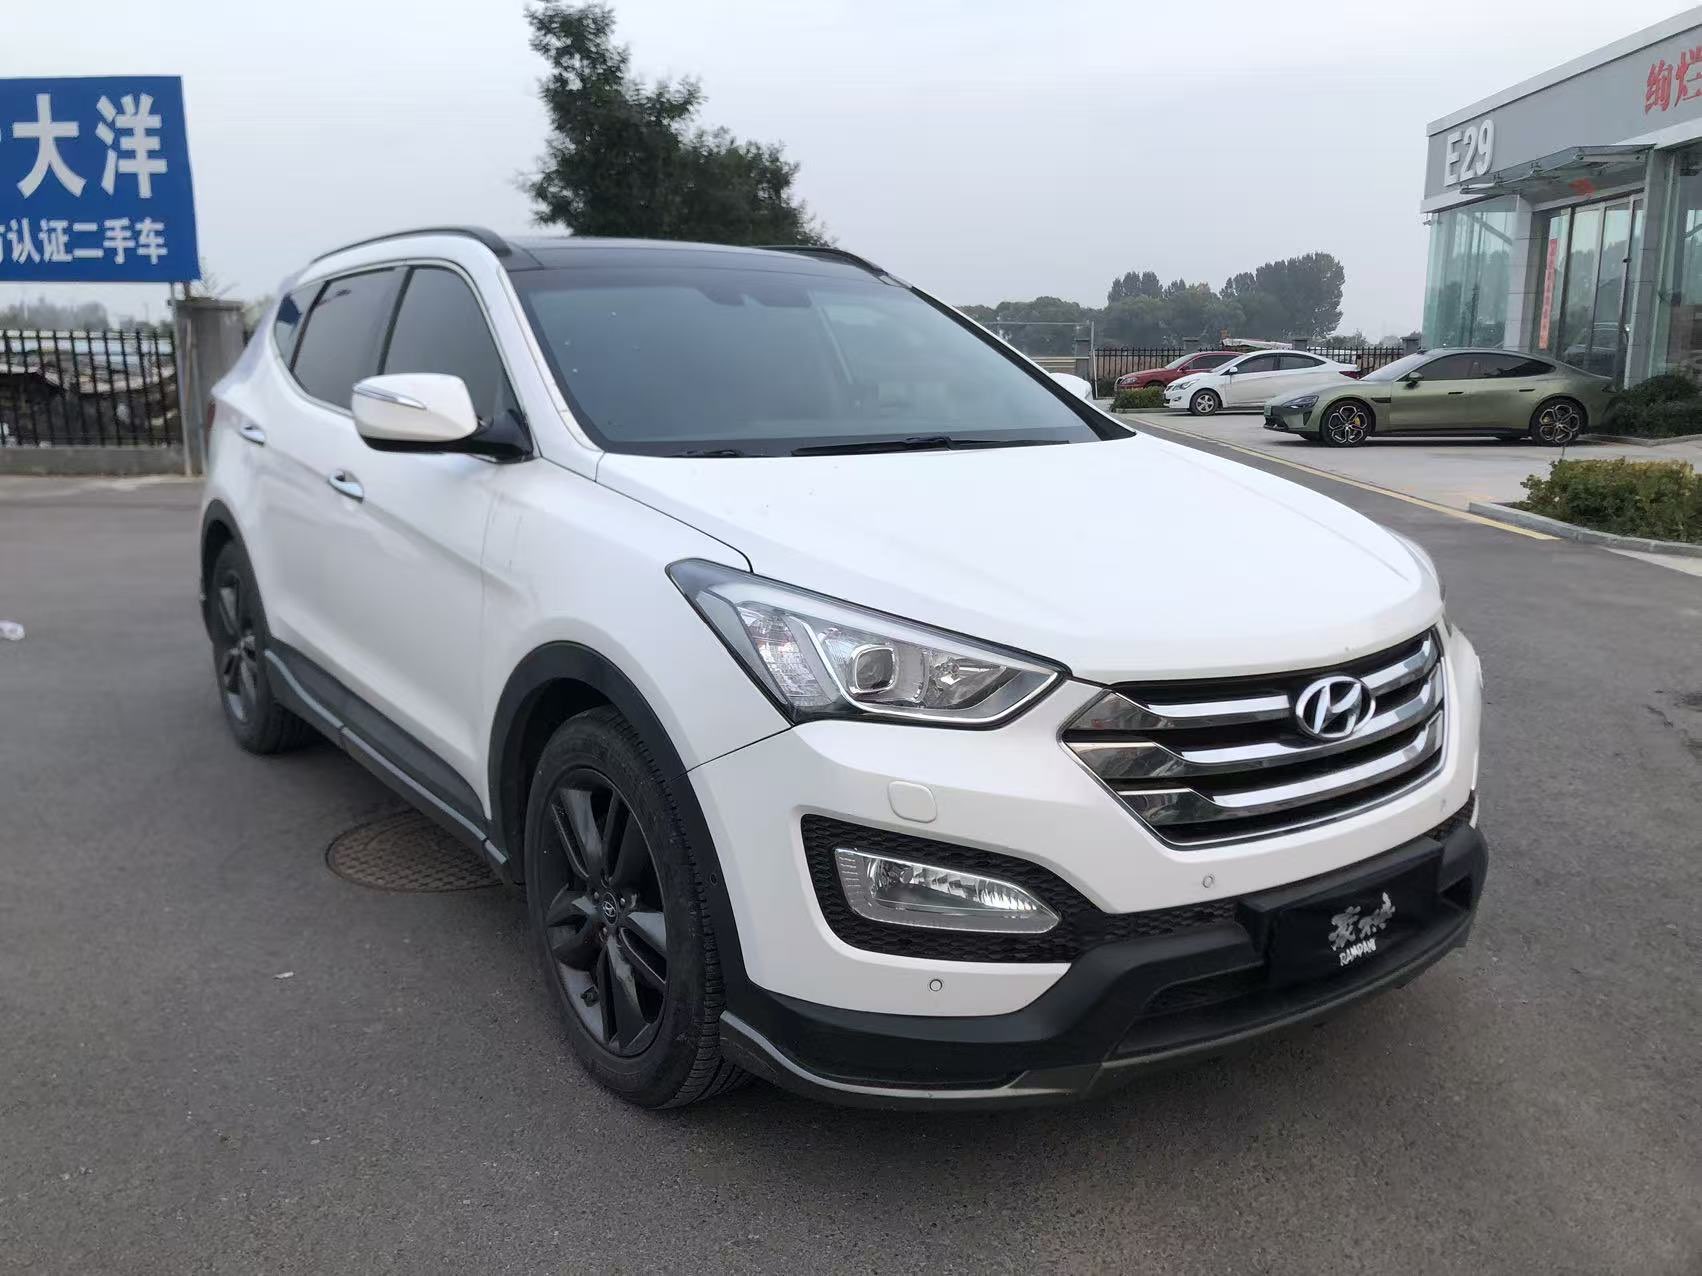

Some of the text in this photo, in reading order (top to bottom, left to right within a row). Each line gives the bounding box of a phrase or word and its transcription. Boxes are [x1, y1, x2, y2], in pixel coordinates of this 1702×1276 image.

[12, 93, 168, 199] 大洋
[1444, 120, 1494, 187] E29
[0, 217, 168, 264] 认证二手车
